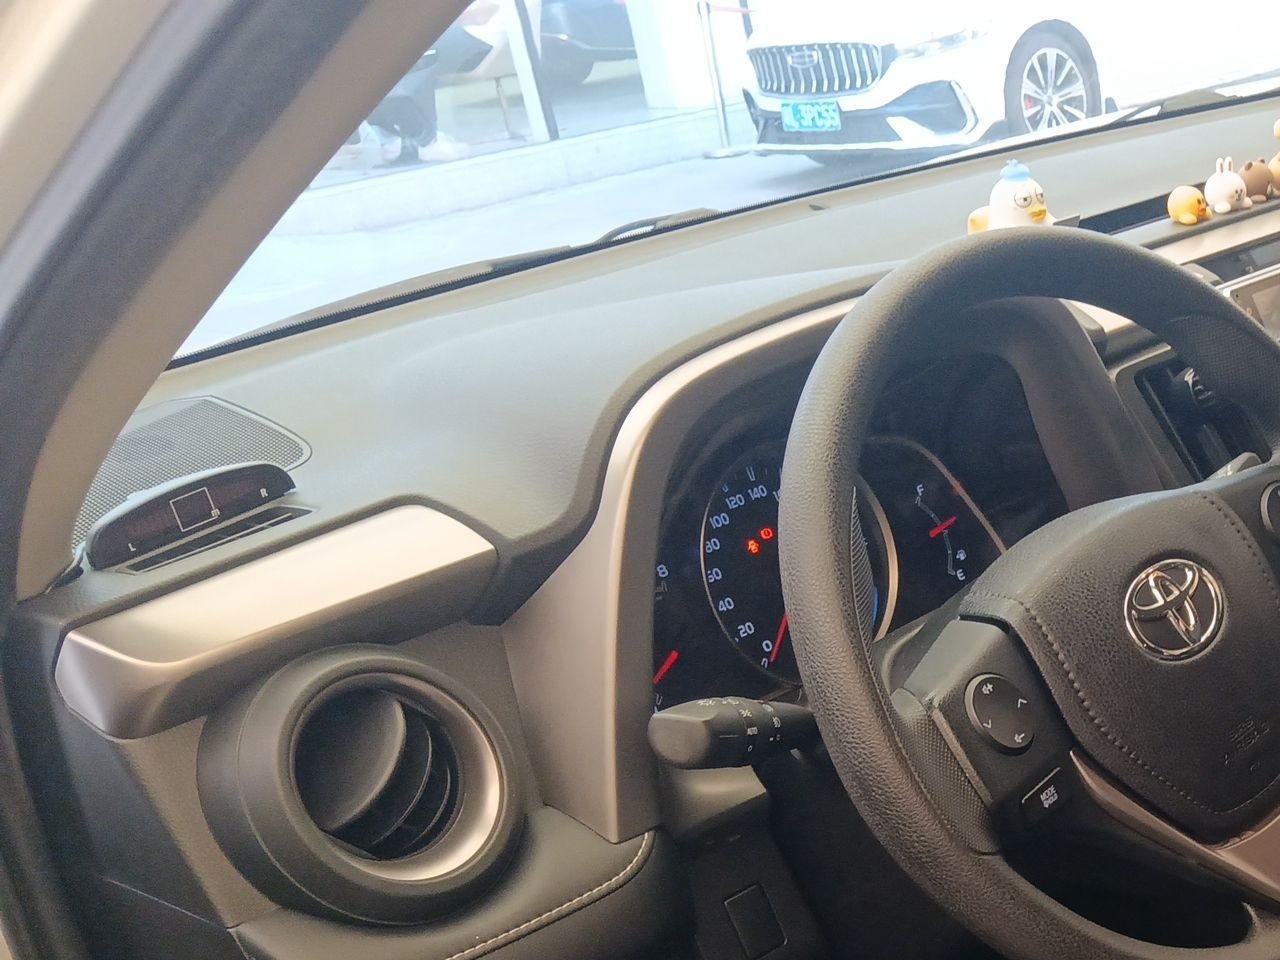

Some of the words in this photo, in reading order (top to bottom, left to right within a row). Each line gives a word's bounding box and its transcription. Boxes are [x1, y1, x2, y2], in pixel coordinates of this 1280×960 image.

[260, 487, 268, 498] R
[748, 485, 768, 500] 140
[916, 484, 924, 496] F
[726, 494, 745, 510] 120
[709, 513, 730, 529] 100
[128, 543, 136, 552] L
[705, 538, 720, 553] 80
[656, 564, 669, 578] 8
[956, 569, 966, 580] E
[718, 597, 735, 612] 40
[737, 621, 755, 638] 20
[762, 640, 773, 652] 0
